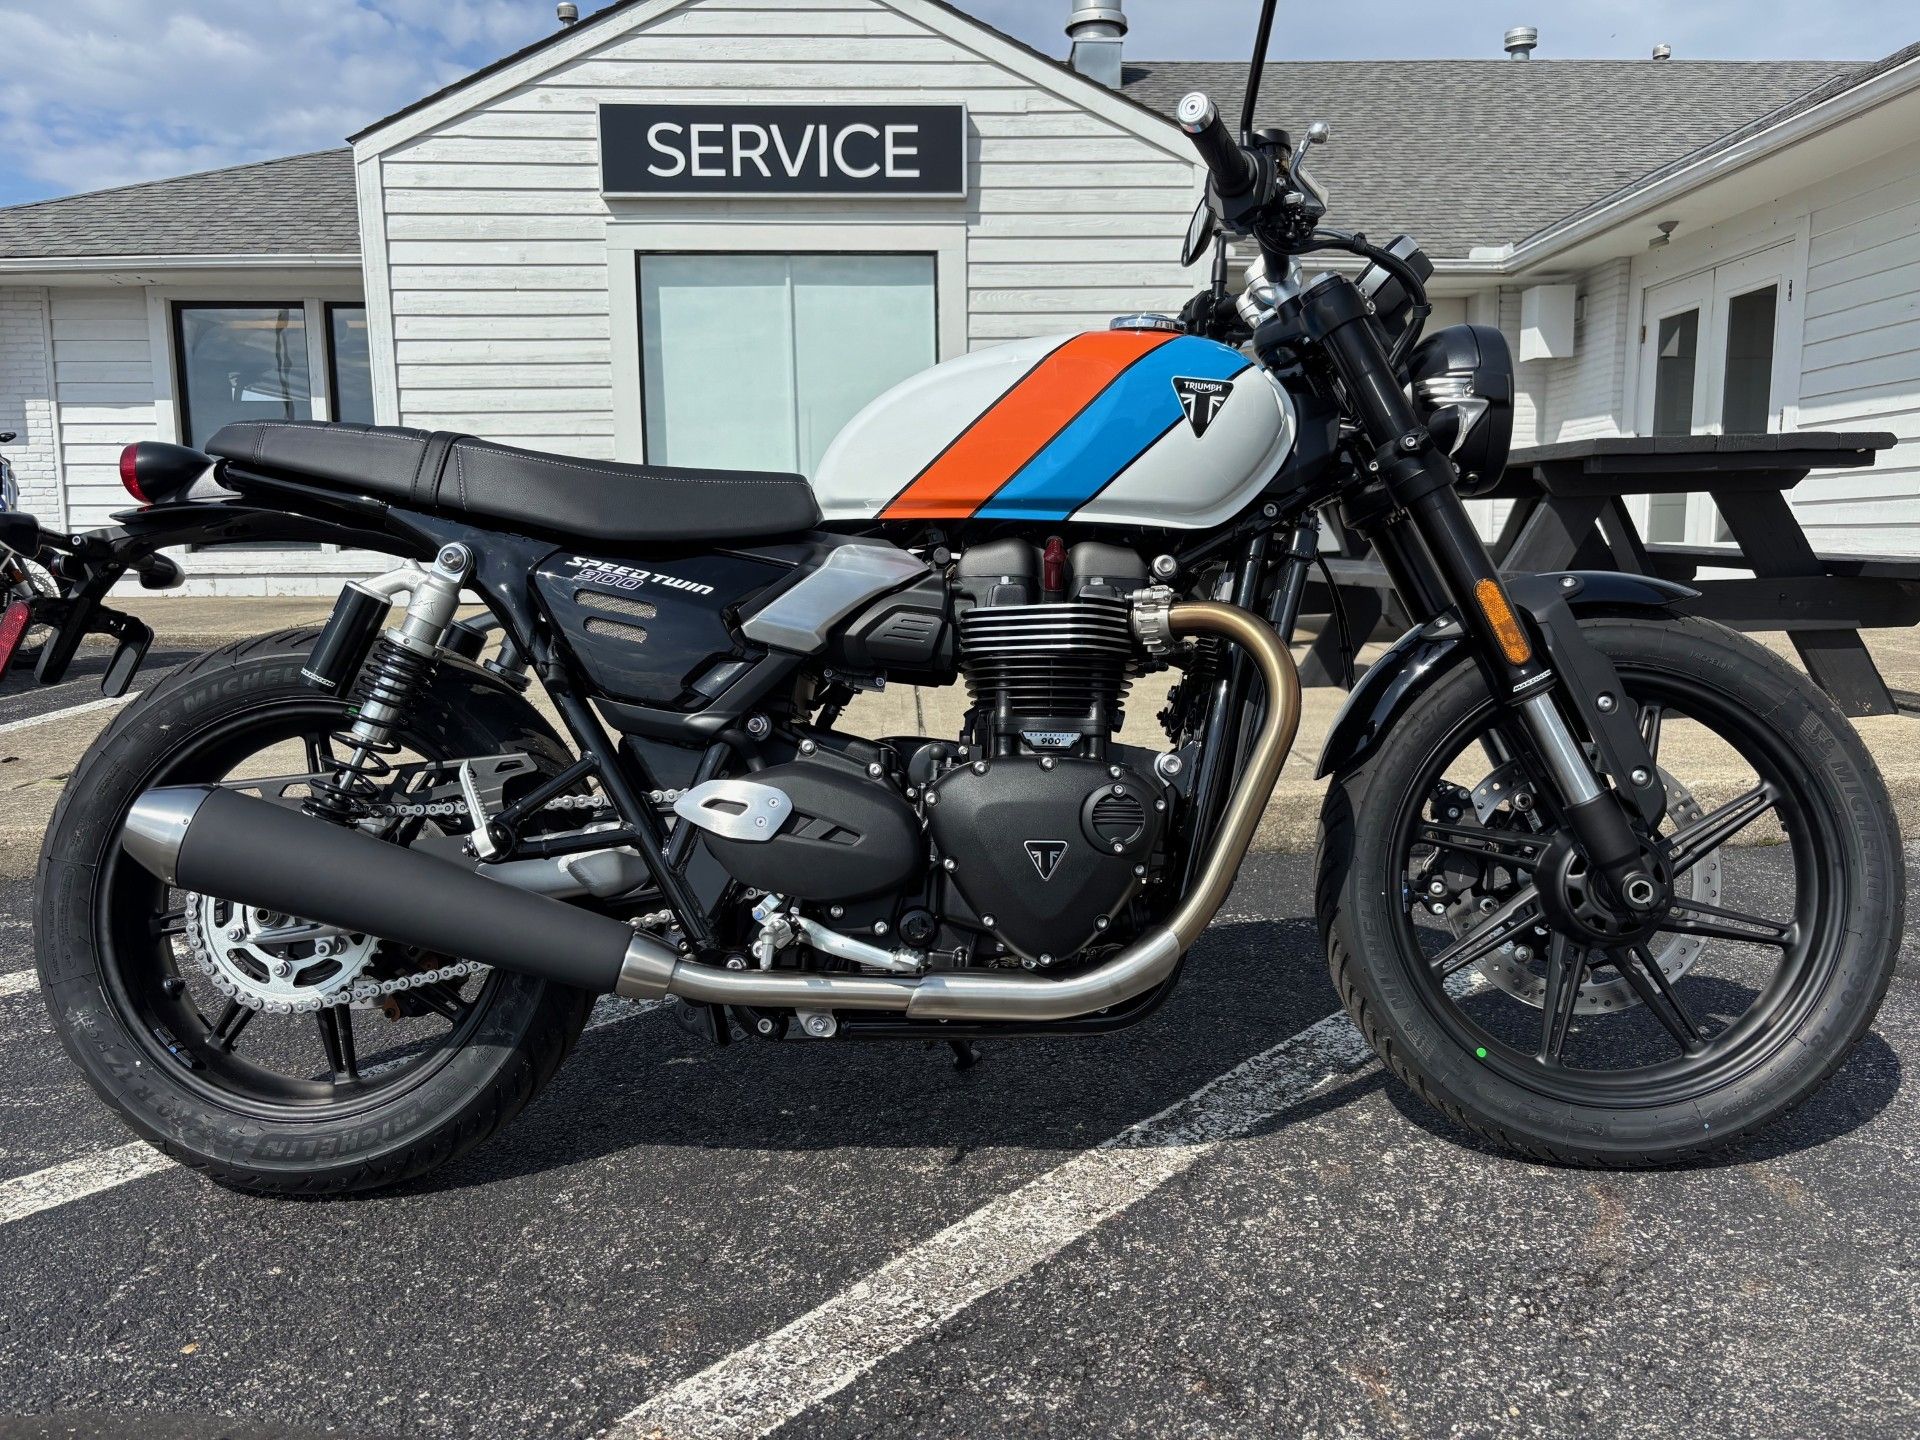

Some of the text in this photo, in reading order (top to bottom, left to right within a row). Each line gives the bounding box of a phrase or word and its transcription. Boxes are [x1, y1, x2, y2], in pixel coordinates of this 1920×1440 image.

[646, 122, 920, 178] SERVICE
[1184, 381, 1222, 392] TRIUMPH
[565, 556, 714, 595] SPEED TWIN
[573, 569, 645, 590] 900
[182, 666, 300, 712] MICHEL
[1830, 755, 1883, 903] MICHELIN
[261, 1110, 424, 1156] MICHELIN
